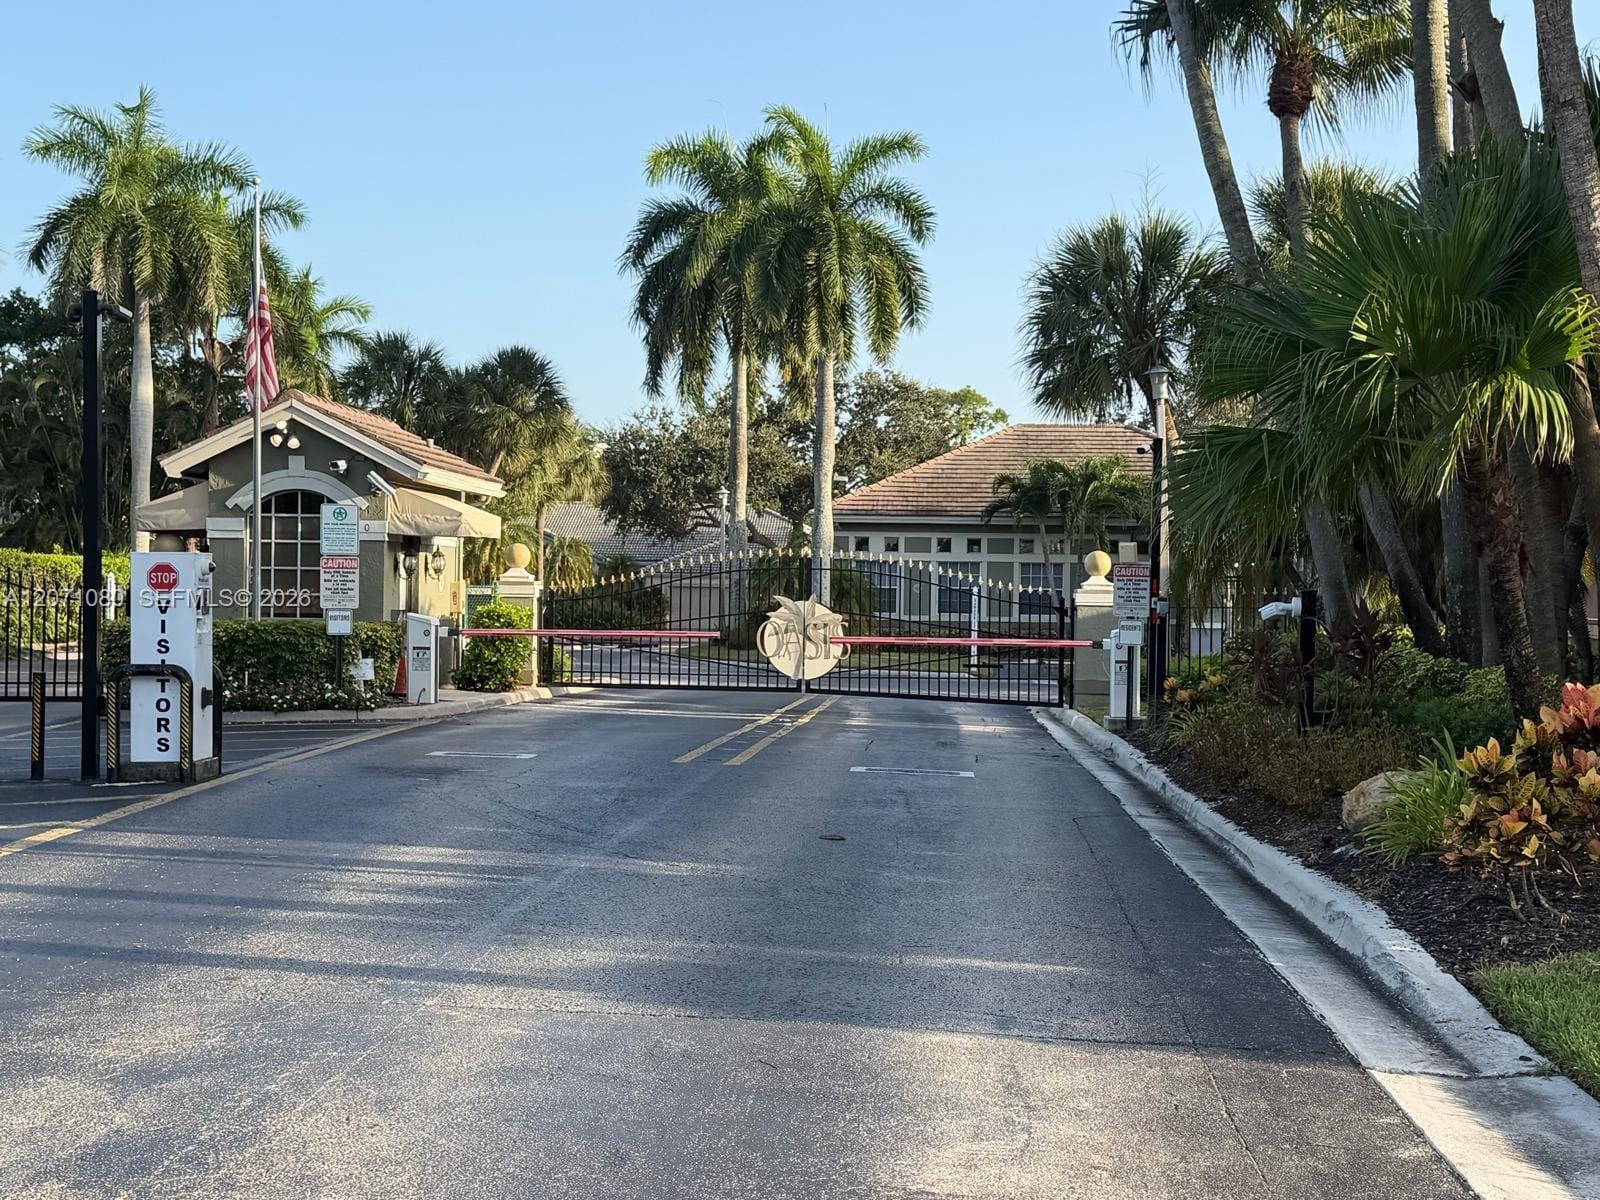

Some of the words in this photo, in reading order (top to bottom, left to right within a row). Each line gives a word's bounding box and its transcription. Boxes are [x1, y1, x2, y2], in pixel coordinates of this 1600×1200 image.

[322, 559, 358, 568] CAUTION
[1115, 567, 1150, 576] CAUTION
[150, 572, 177, 584] STOP
[756, 620, 851, 660] OASIS
